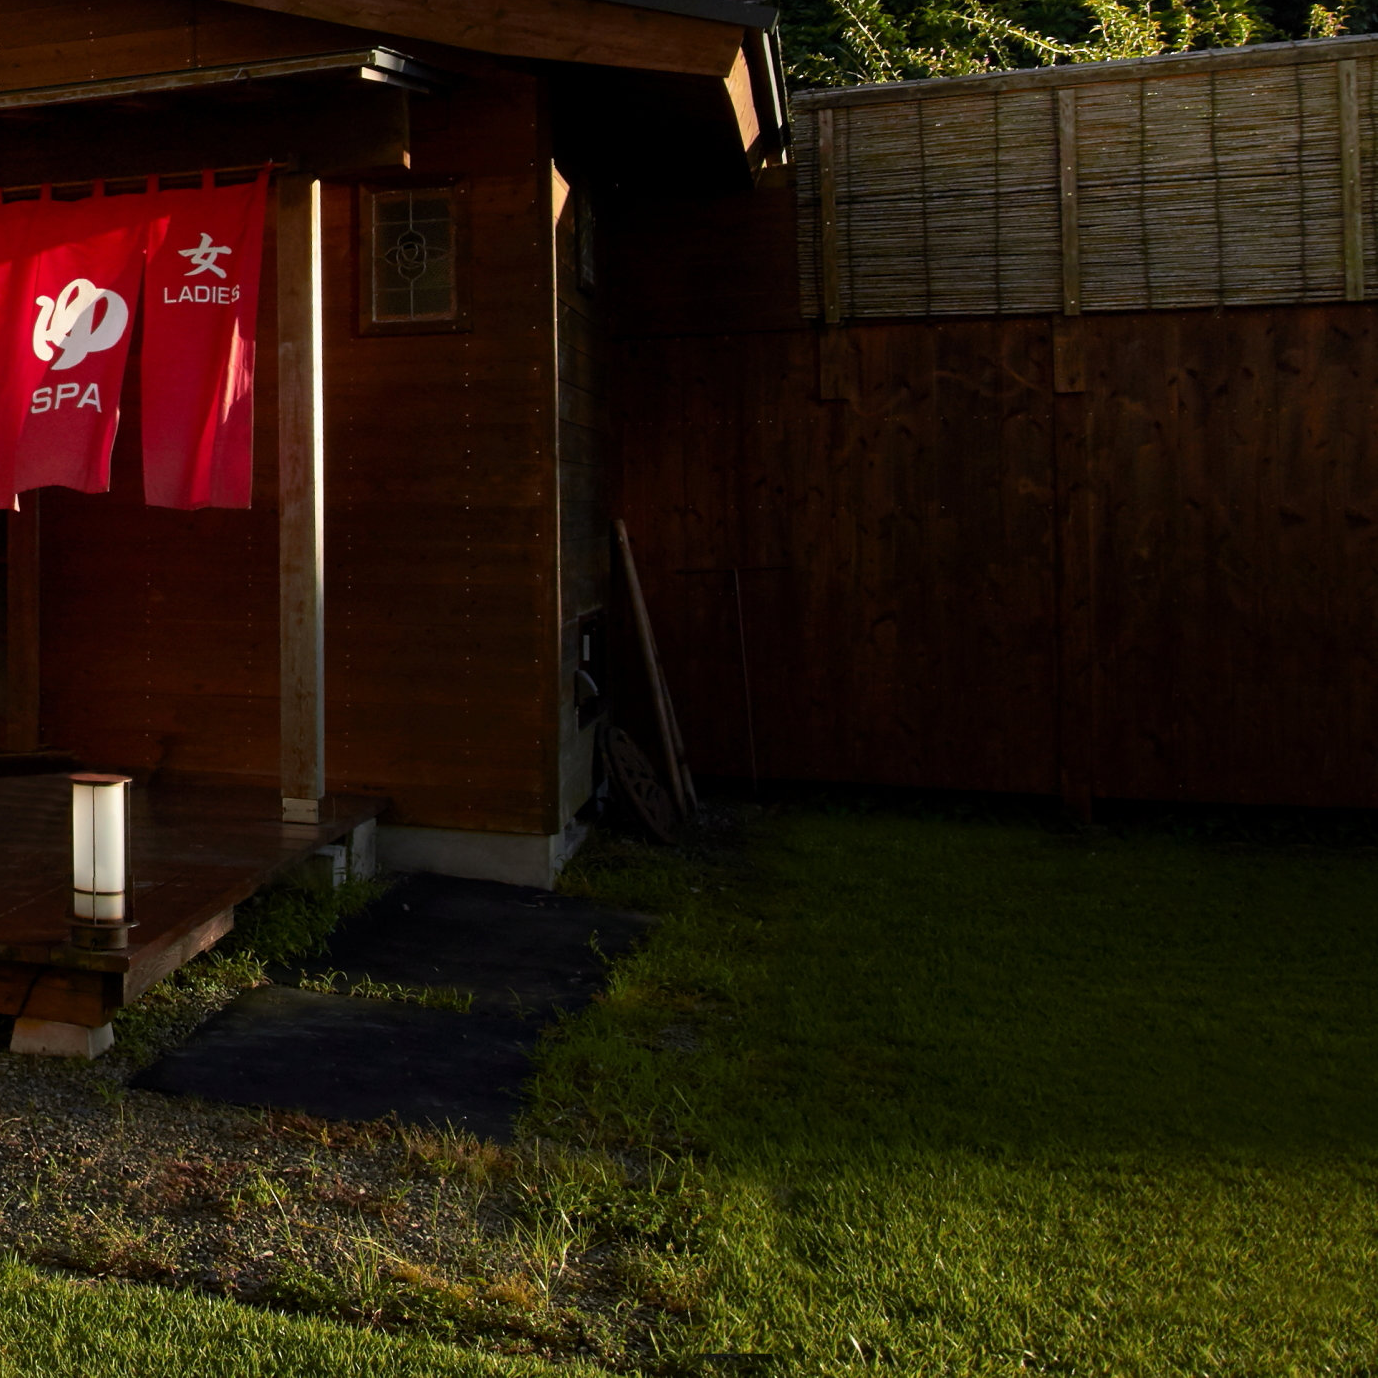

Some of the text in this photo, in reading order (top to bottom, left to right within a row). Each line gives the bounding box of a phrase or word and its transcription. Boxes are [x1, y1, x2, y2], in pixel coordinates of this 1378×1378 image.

[177, 232, 232, 278] 女
[163, 284, 240, 305] LADIES
[32, 278, 129, 371] ゆ
[30, 382, 102, 414] SPA
